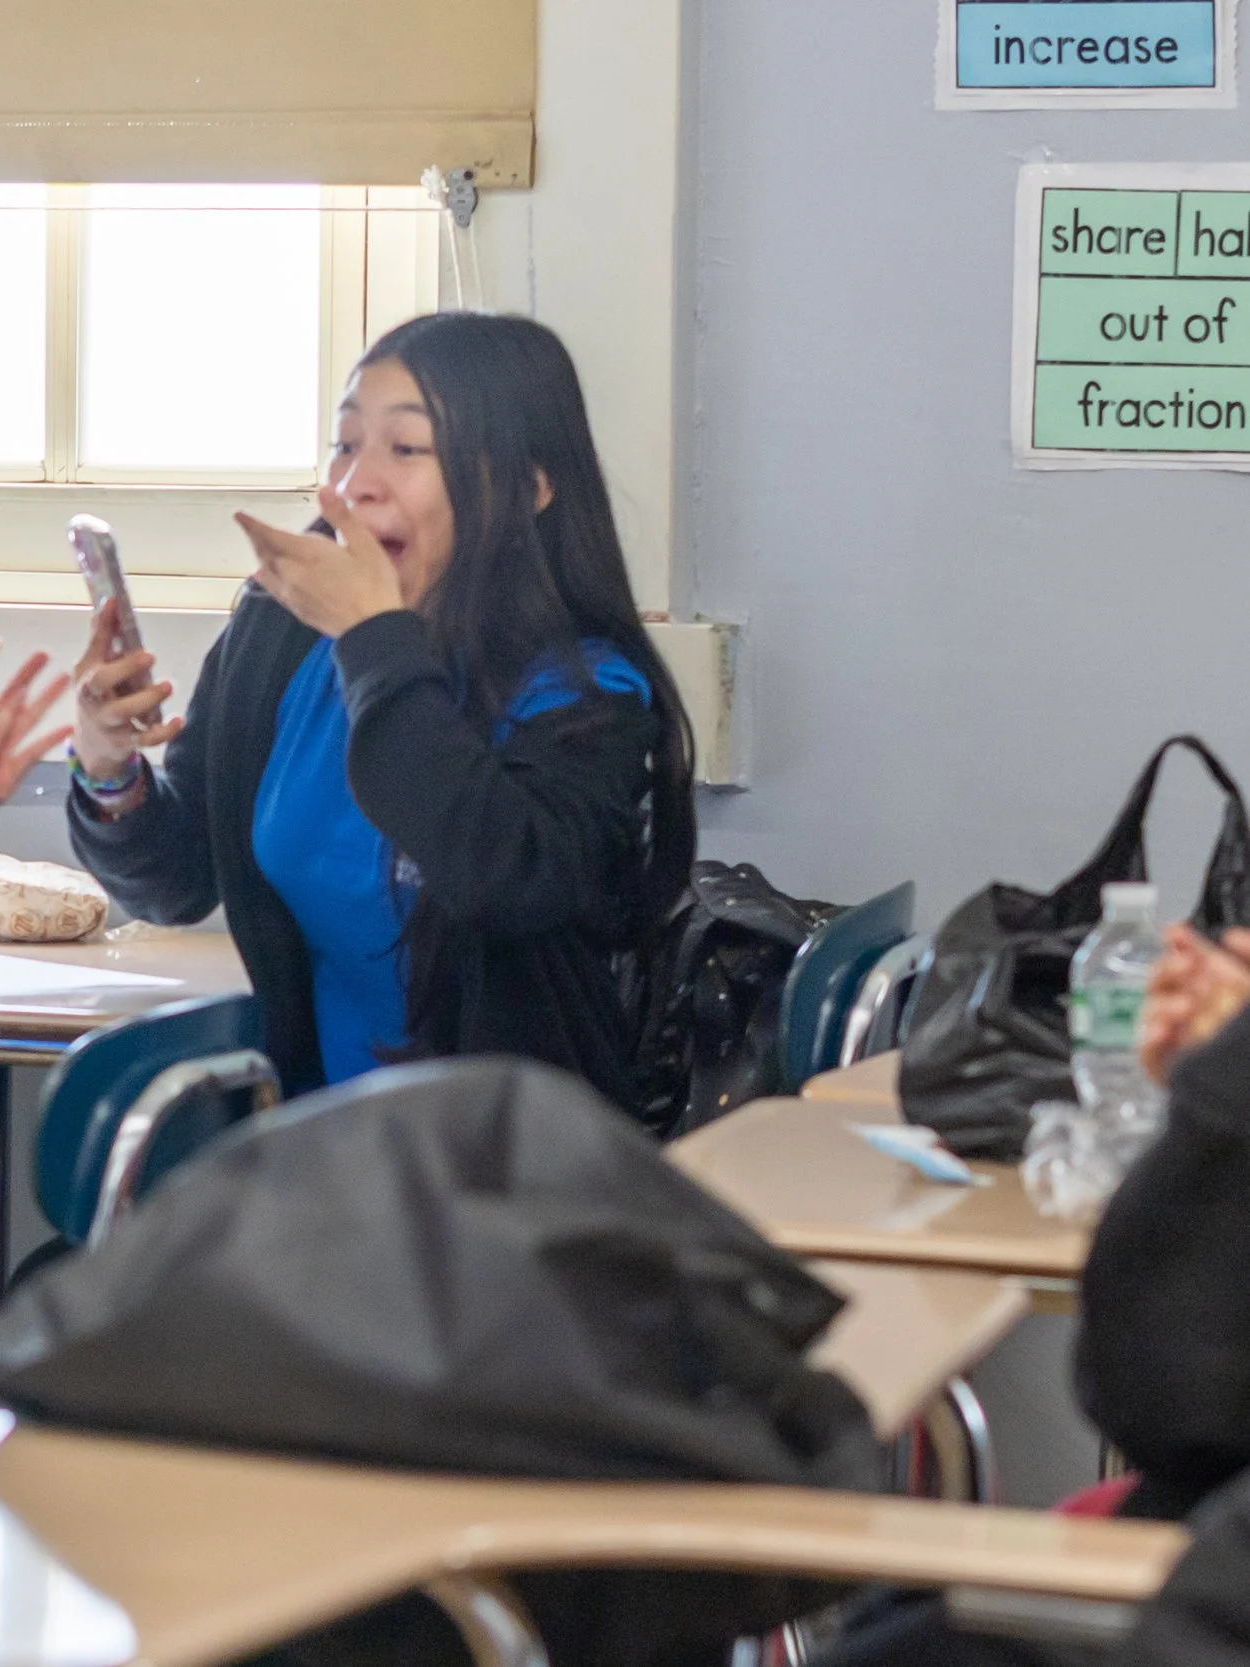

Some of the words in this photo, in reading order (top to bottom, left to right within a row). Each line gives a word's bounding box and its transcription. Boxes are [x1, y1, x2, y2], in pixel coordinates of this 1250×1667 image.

[993, 24, 1179, 65] increase
[1051, 207, 1166, 254] share
[1099, 305, 1168, 342] out
[1183, 297, 1236, 344] of
[1078, 380, 1246, 430] fraction
